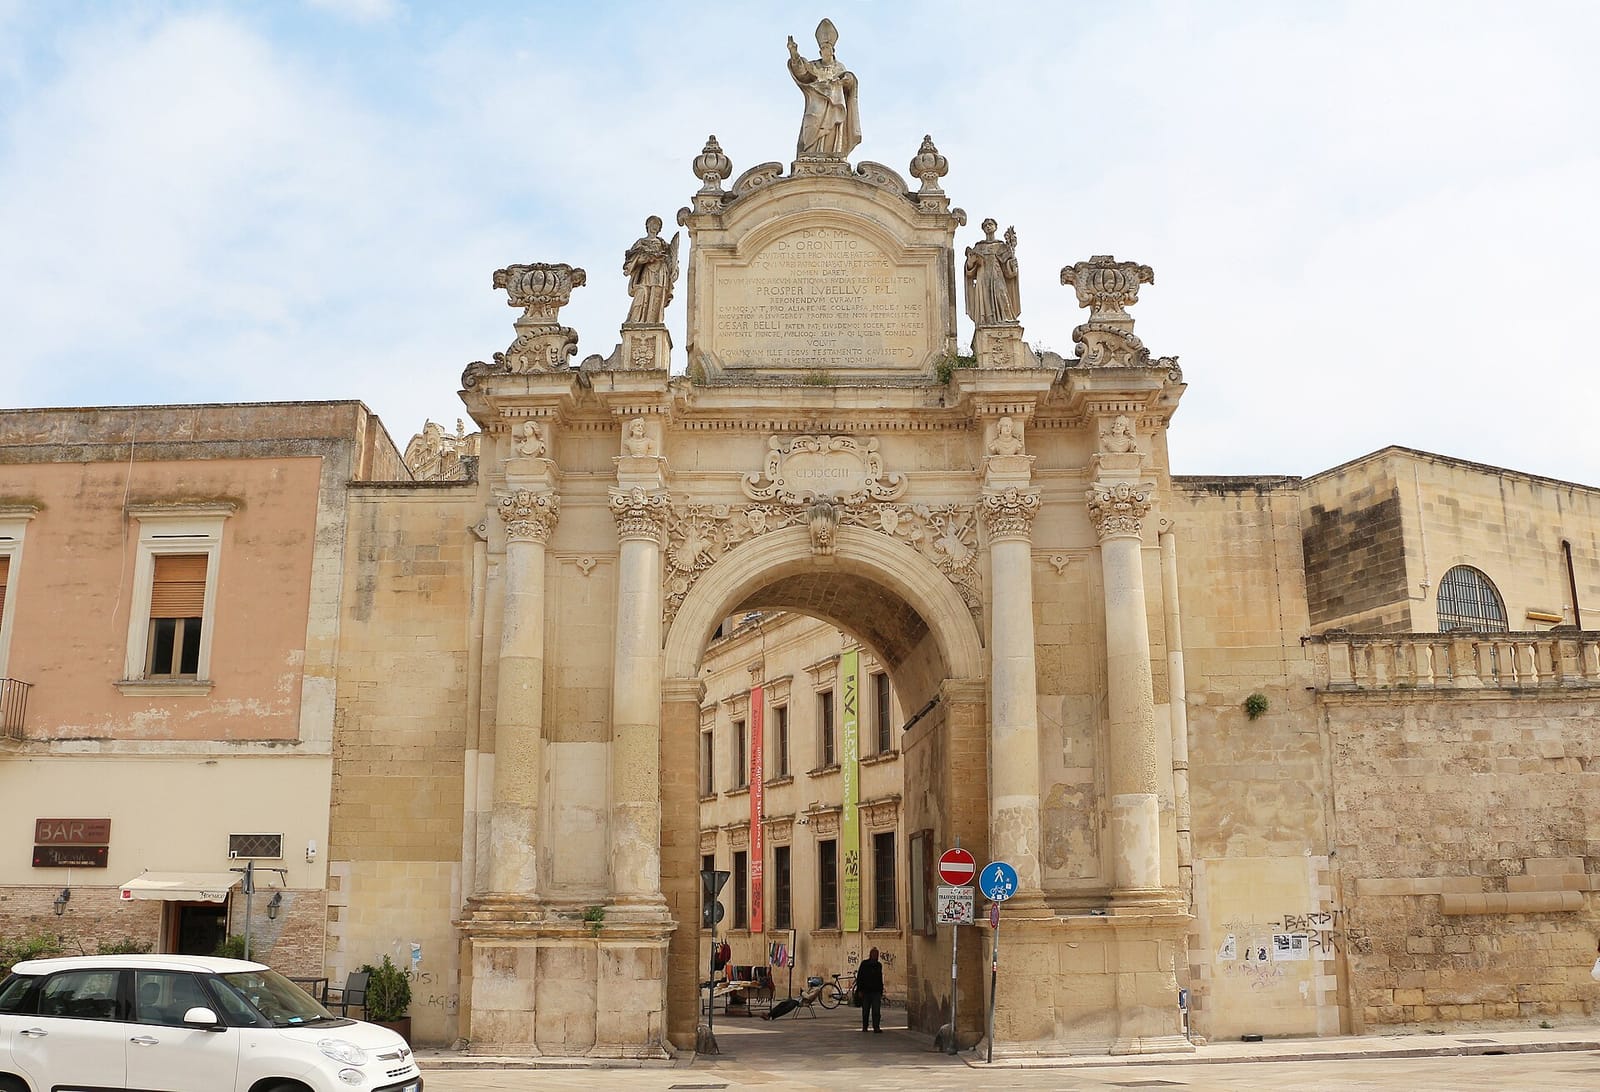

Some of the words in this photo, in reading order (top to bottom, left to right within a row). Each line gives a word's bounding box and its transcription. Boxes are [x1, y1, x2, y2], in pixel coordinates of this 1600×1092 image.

[796, 241, 857, 250] ORONTIO
[757, 287, 804, 295] PROSPER
[811, 286, 868, 295] LVBELLVS
[754, 321, 781, 330] BELLI
[38, 822, 85, 841] BAR
